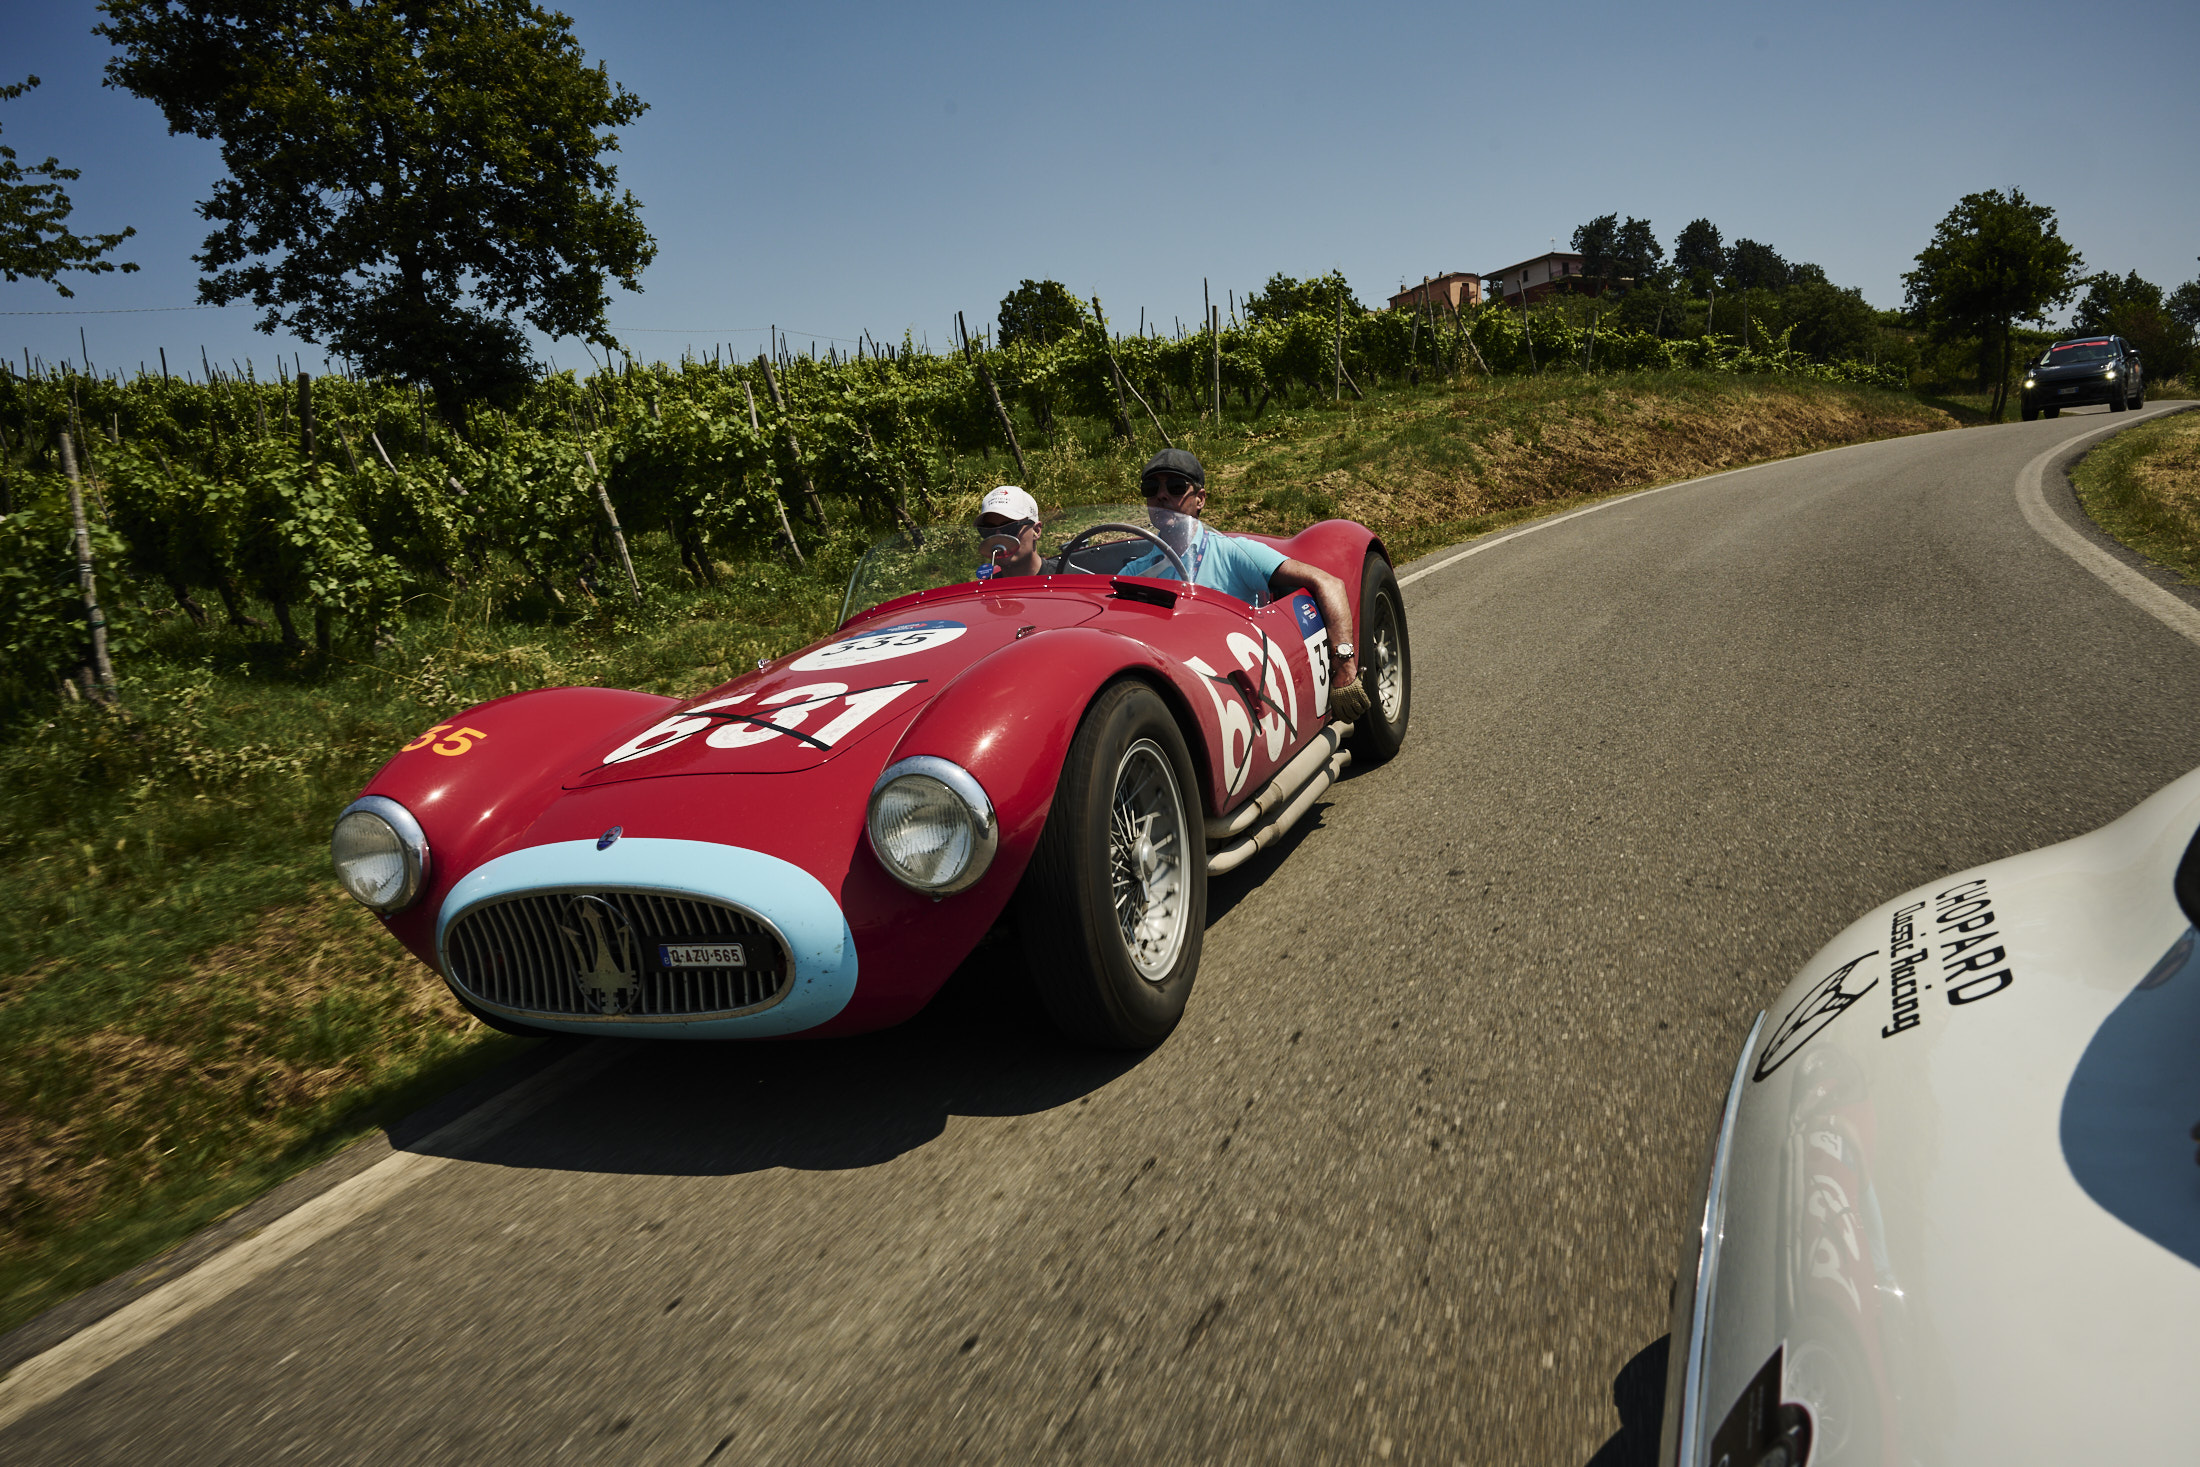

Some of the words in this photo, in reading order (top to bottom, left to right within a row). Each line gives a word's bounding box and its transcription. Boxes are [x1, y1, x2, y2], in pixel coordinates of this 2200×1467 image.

[821, 631, 937, 656] 335
[603, 681, 919, 764] 631
[1890, 901, 1927, 959] Classic
[1935, 879, 2013, 1006] CHOPARD
[1881, 948, 1932, 1039] Racing
